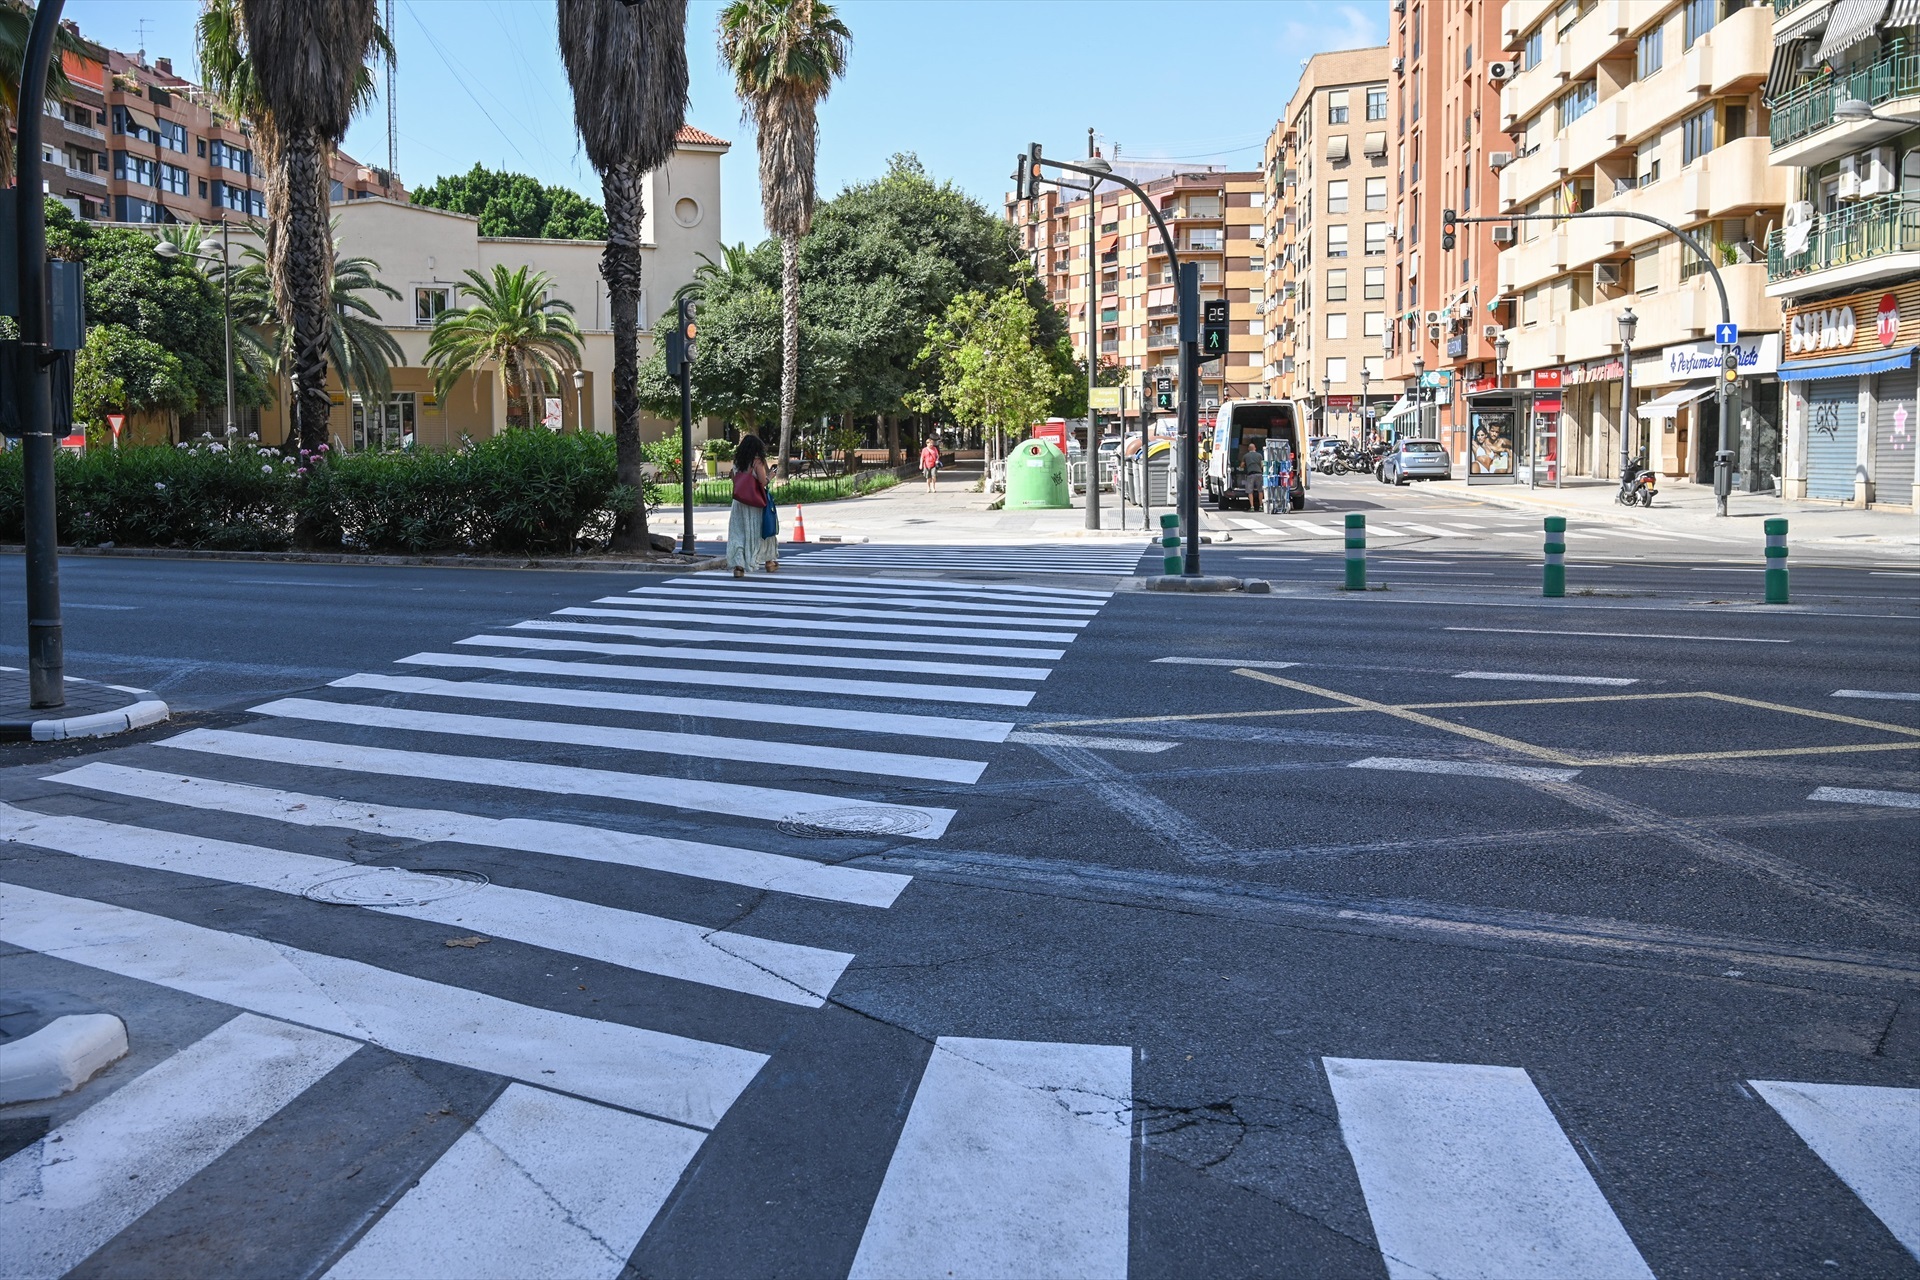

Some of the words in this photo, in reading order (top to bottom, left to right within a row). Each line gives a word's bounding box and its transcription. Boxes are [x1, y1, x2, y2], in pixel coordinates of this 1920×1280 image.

[1208, 307, 1225, 321] 25
[1789, 305, 1856, 354] SUMO
[1158, 380, 1170, 390] 25
